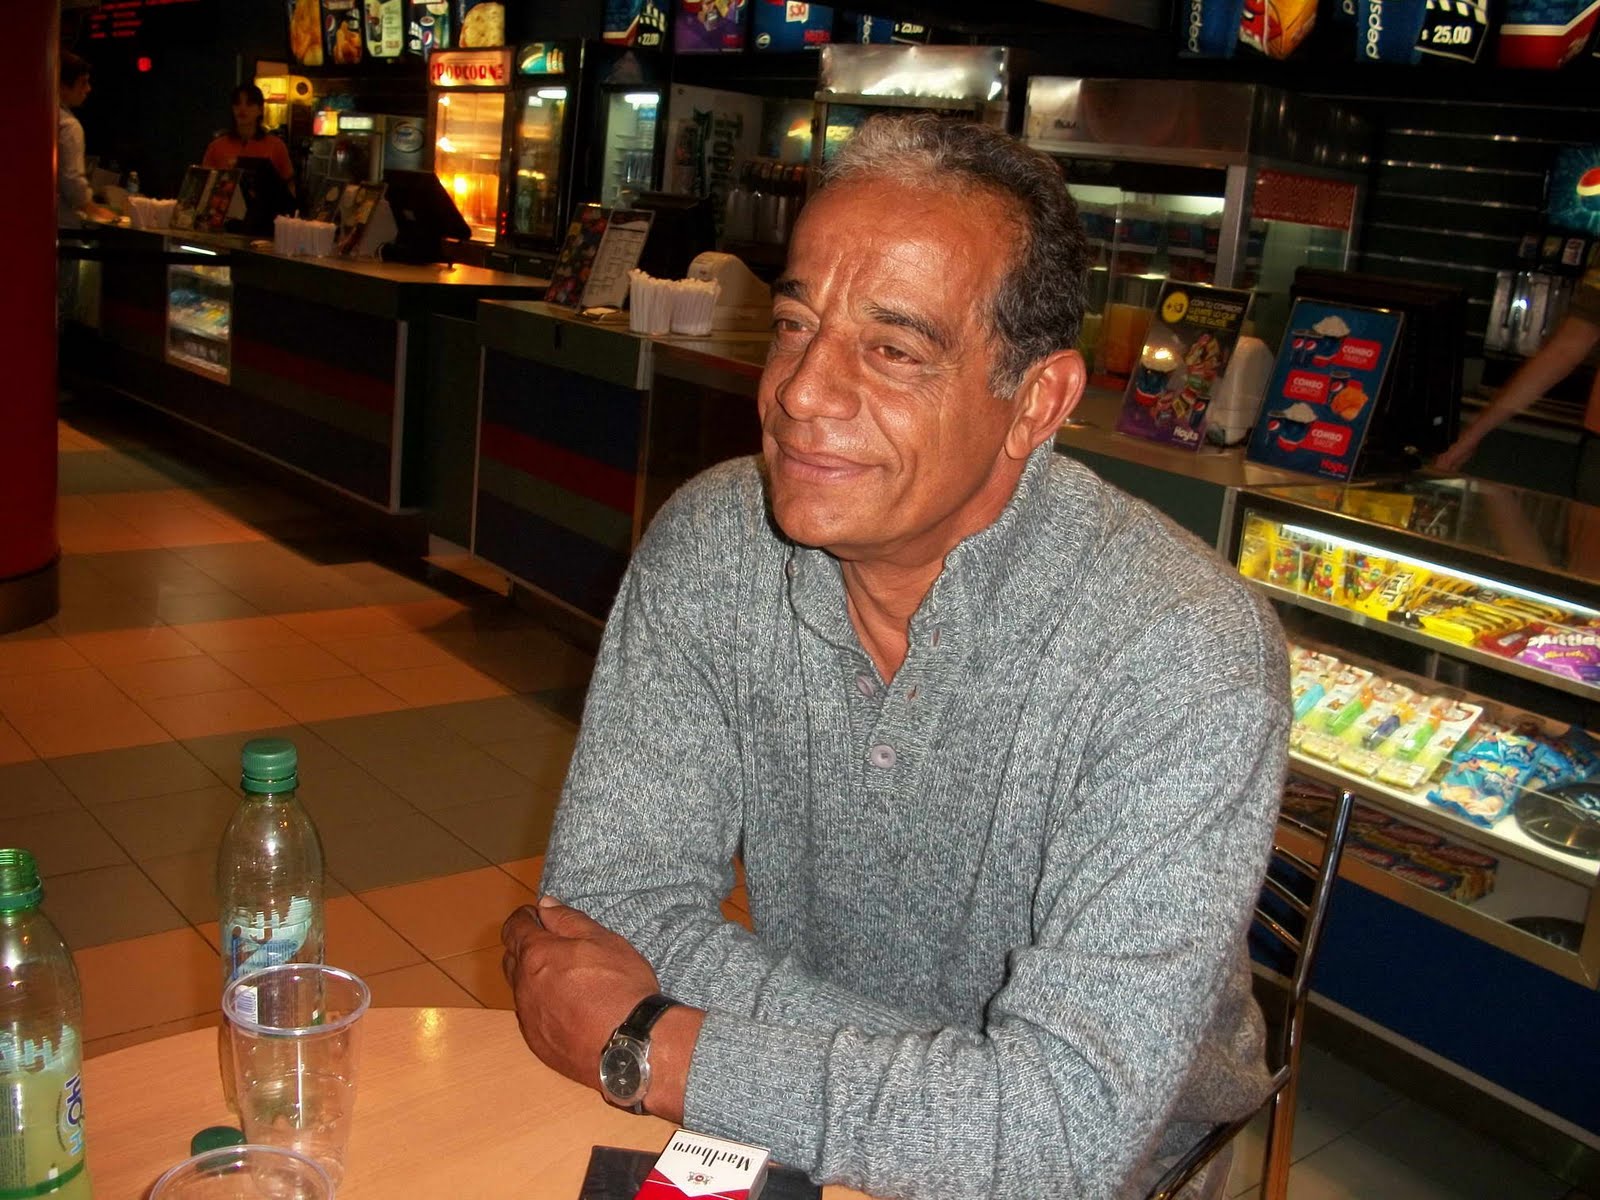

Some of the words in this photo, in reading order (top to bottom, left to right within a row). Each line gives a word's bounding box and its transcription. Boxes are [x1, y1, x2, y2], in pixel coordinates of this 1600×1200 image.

[1188, 0, 1202, 53] peps
[1432, 25, 1473, 45] 25,00
[435, 63, 497, 80] POPCORN
[1342, 344, 1375, 358] COMBO
[1293, 377, 1324, 390] COMBO
[1173, 425, 1199, 441] Hoyts
[1312, 428, 1343, 443] COMBO
[672, 1141, 754, 1172] Marlboro
